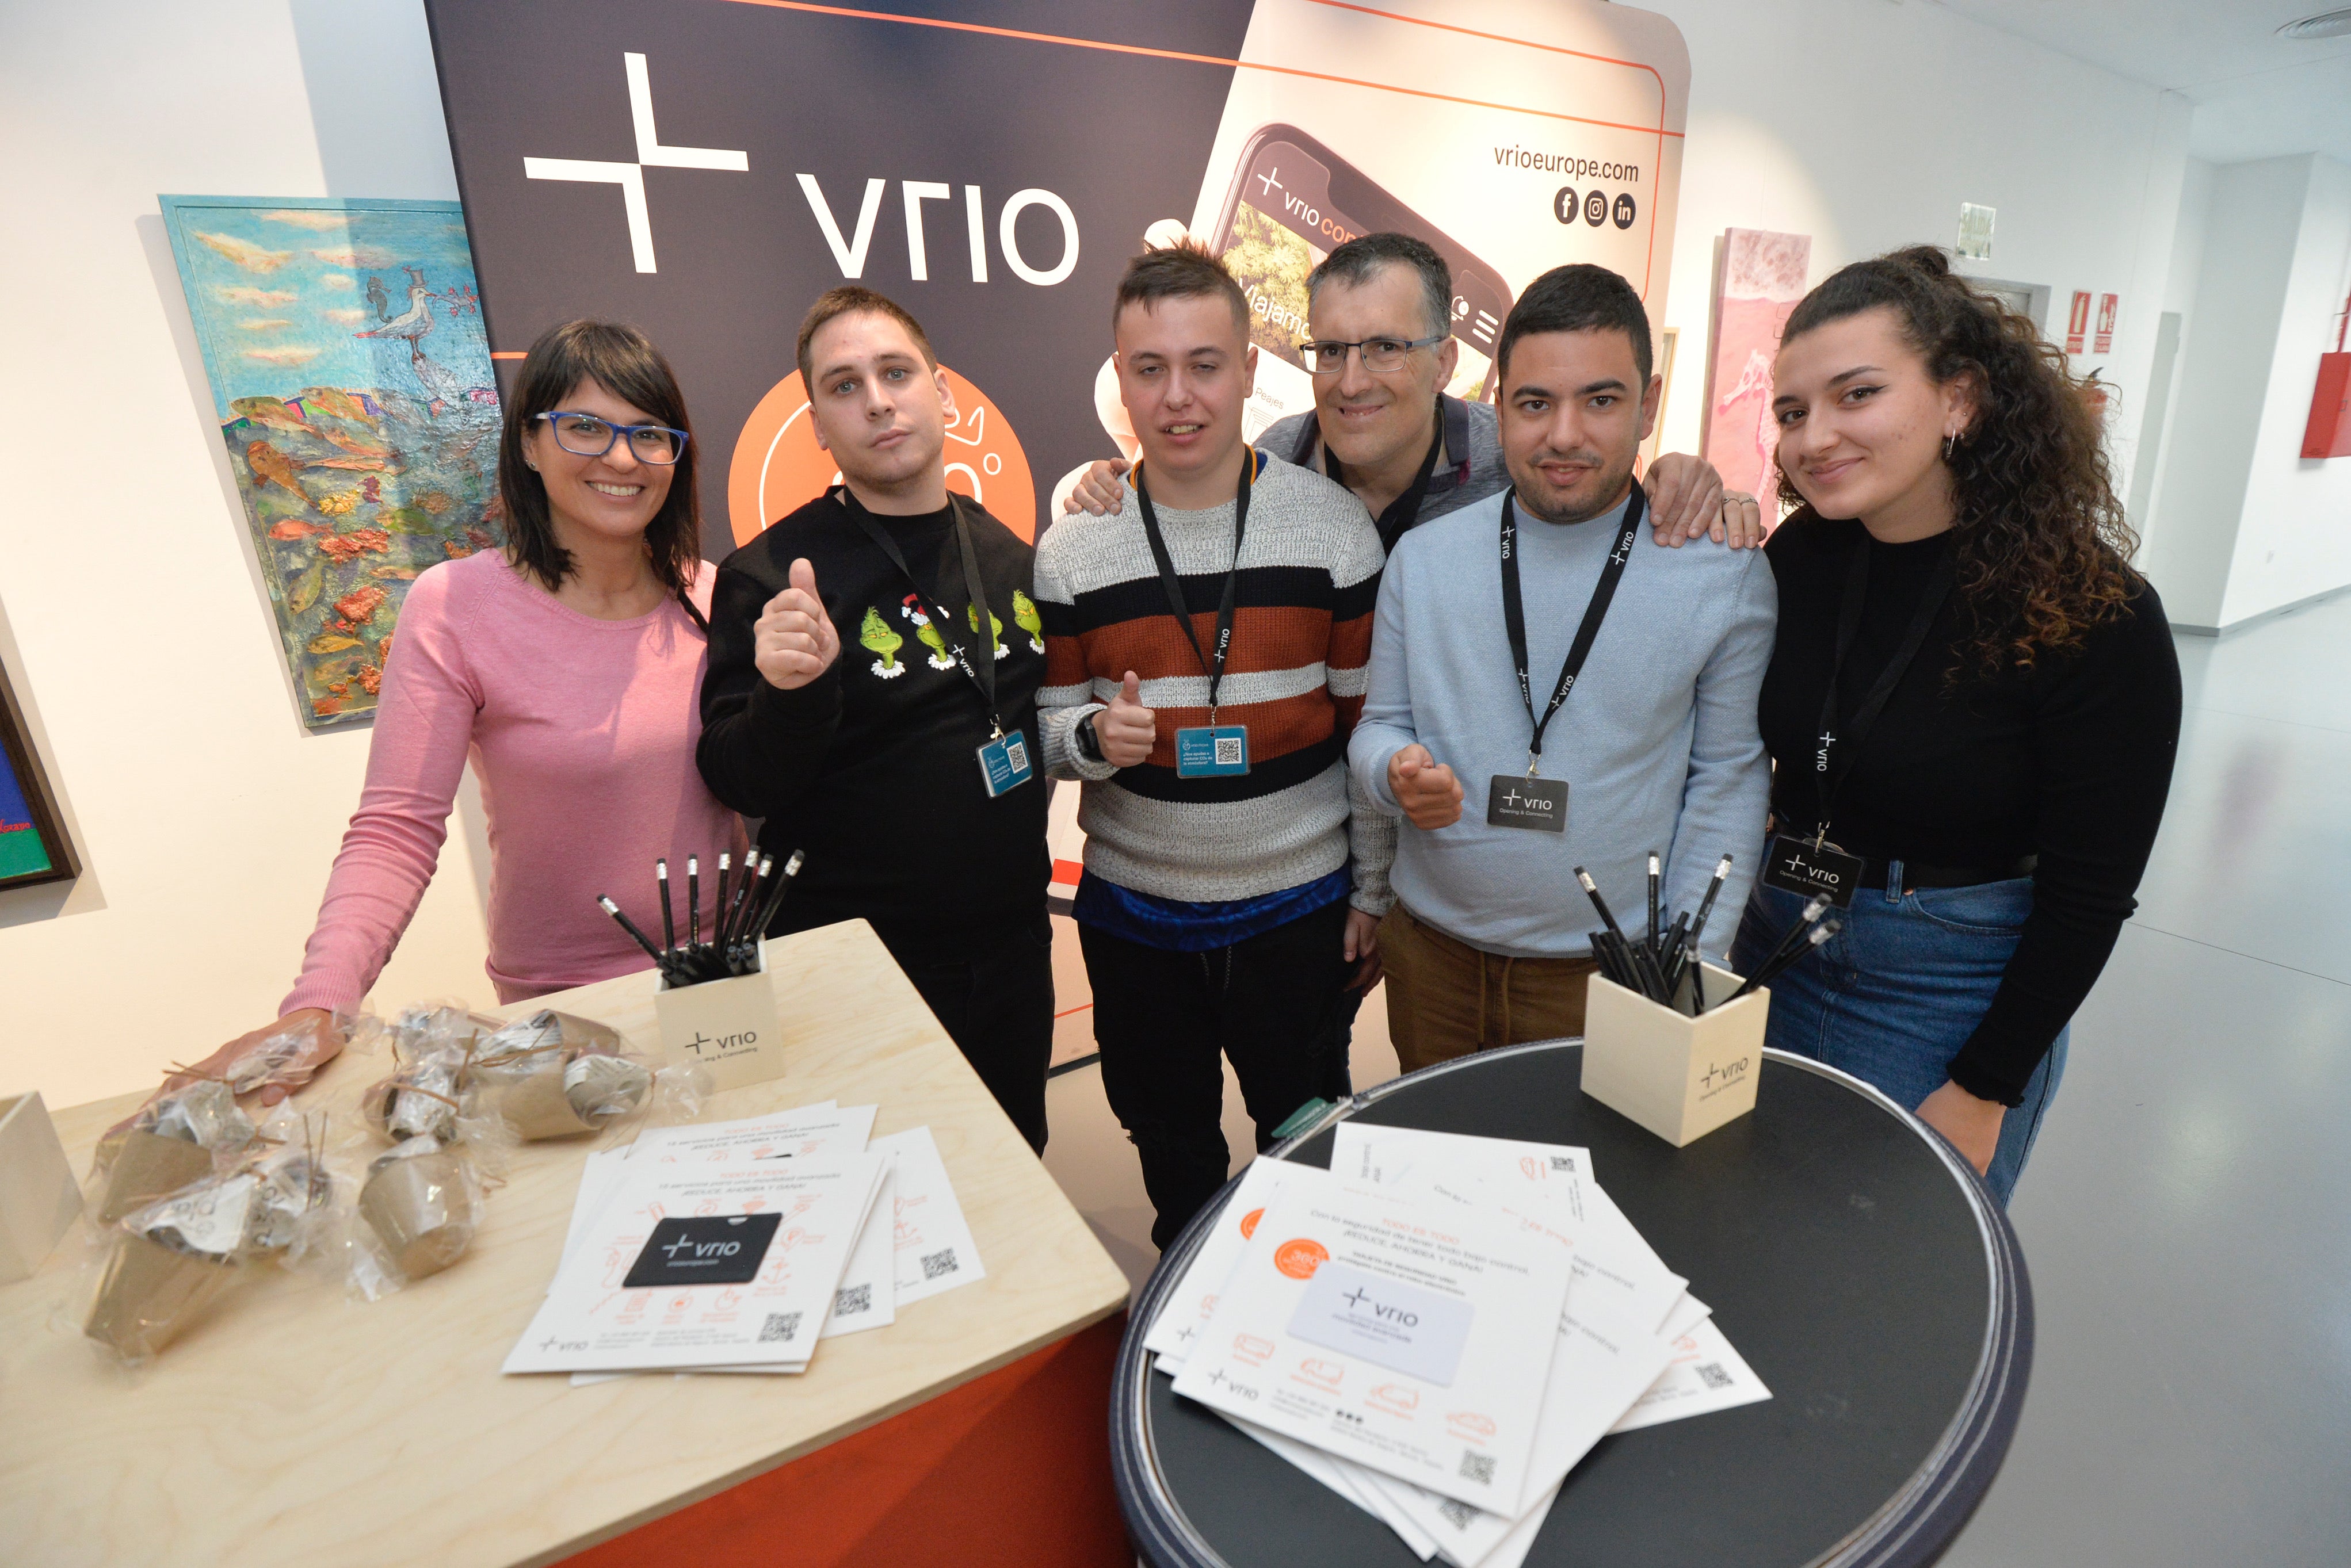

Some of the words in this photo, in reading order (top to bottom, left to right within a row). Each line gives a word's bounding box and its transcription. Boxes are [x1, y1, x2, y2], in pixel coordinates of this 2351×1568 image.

[1495, 144, 1639, 182] vrioeurope.com
[1285, 192, 1320, 226] vrio
[795, 173, 1079, 286] vrio
[1254, 387, 1284, 410] Peajes
[1502, 540, 1510, 559] vrio
[1620, 531, 1635, 552] vrio
[1220, 628, 1230, 648] vrio
[960, 658, 974, 677] vrio
[1559, 675, 1574, 695] vrio
[1817, 748, 1827, 771] vrio
[1524, 798, 1552, 810] vrio
[1525, 810, 1553, 819] Connecting
[1780, 870, 1802, 881] Opening
[1808, 879, 1838, 893] Connecting
[1809, 866, 1839, 884] vrio
[717, 1031, 757, 1049] vrio
[1722, 1057, 1748, 1080] vrio
[695, 1241, 742, 1257] vrio
[1376, 1302, 1418, 1328] vrio
